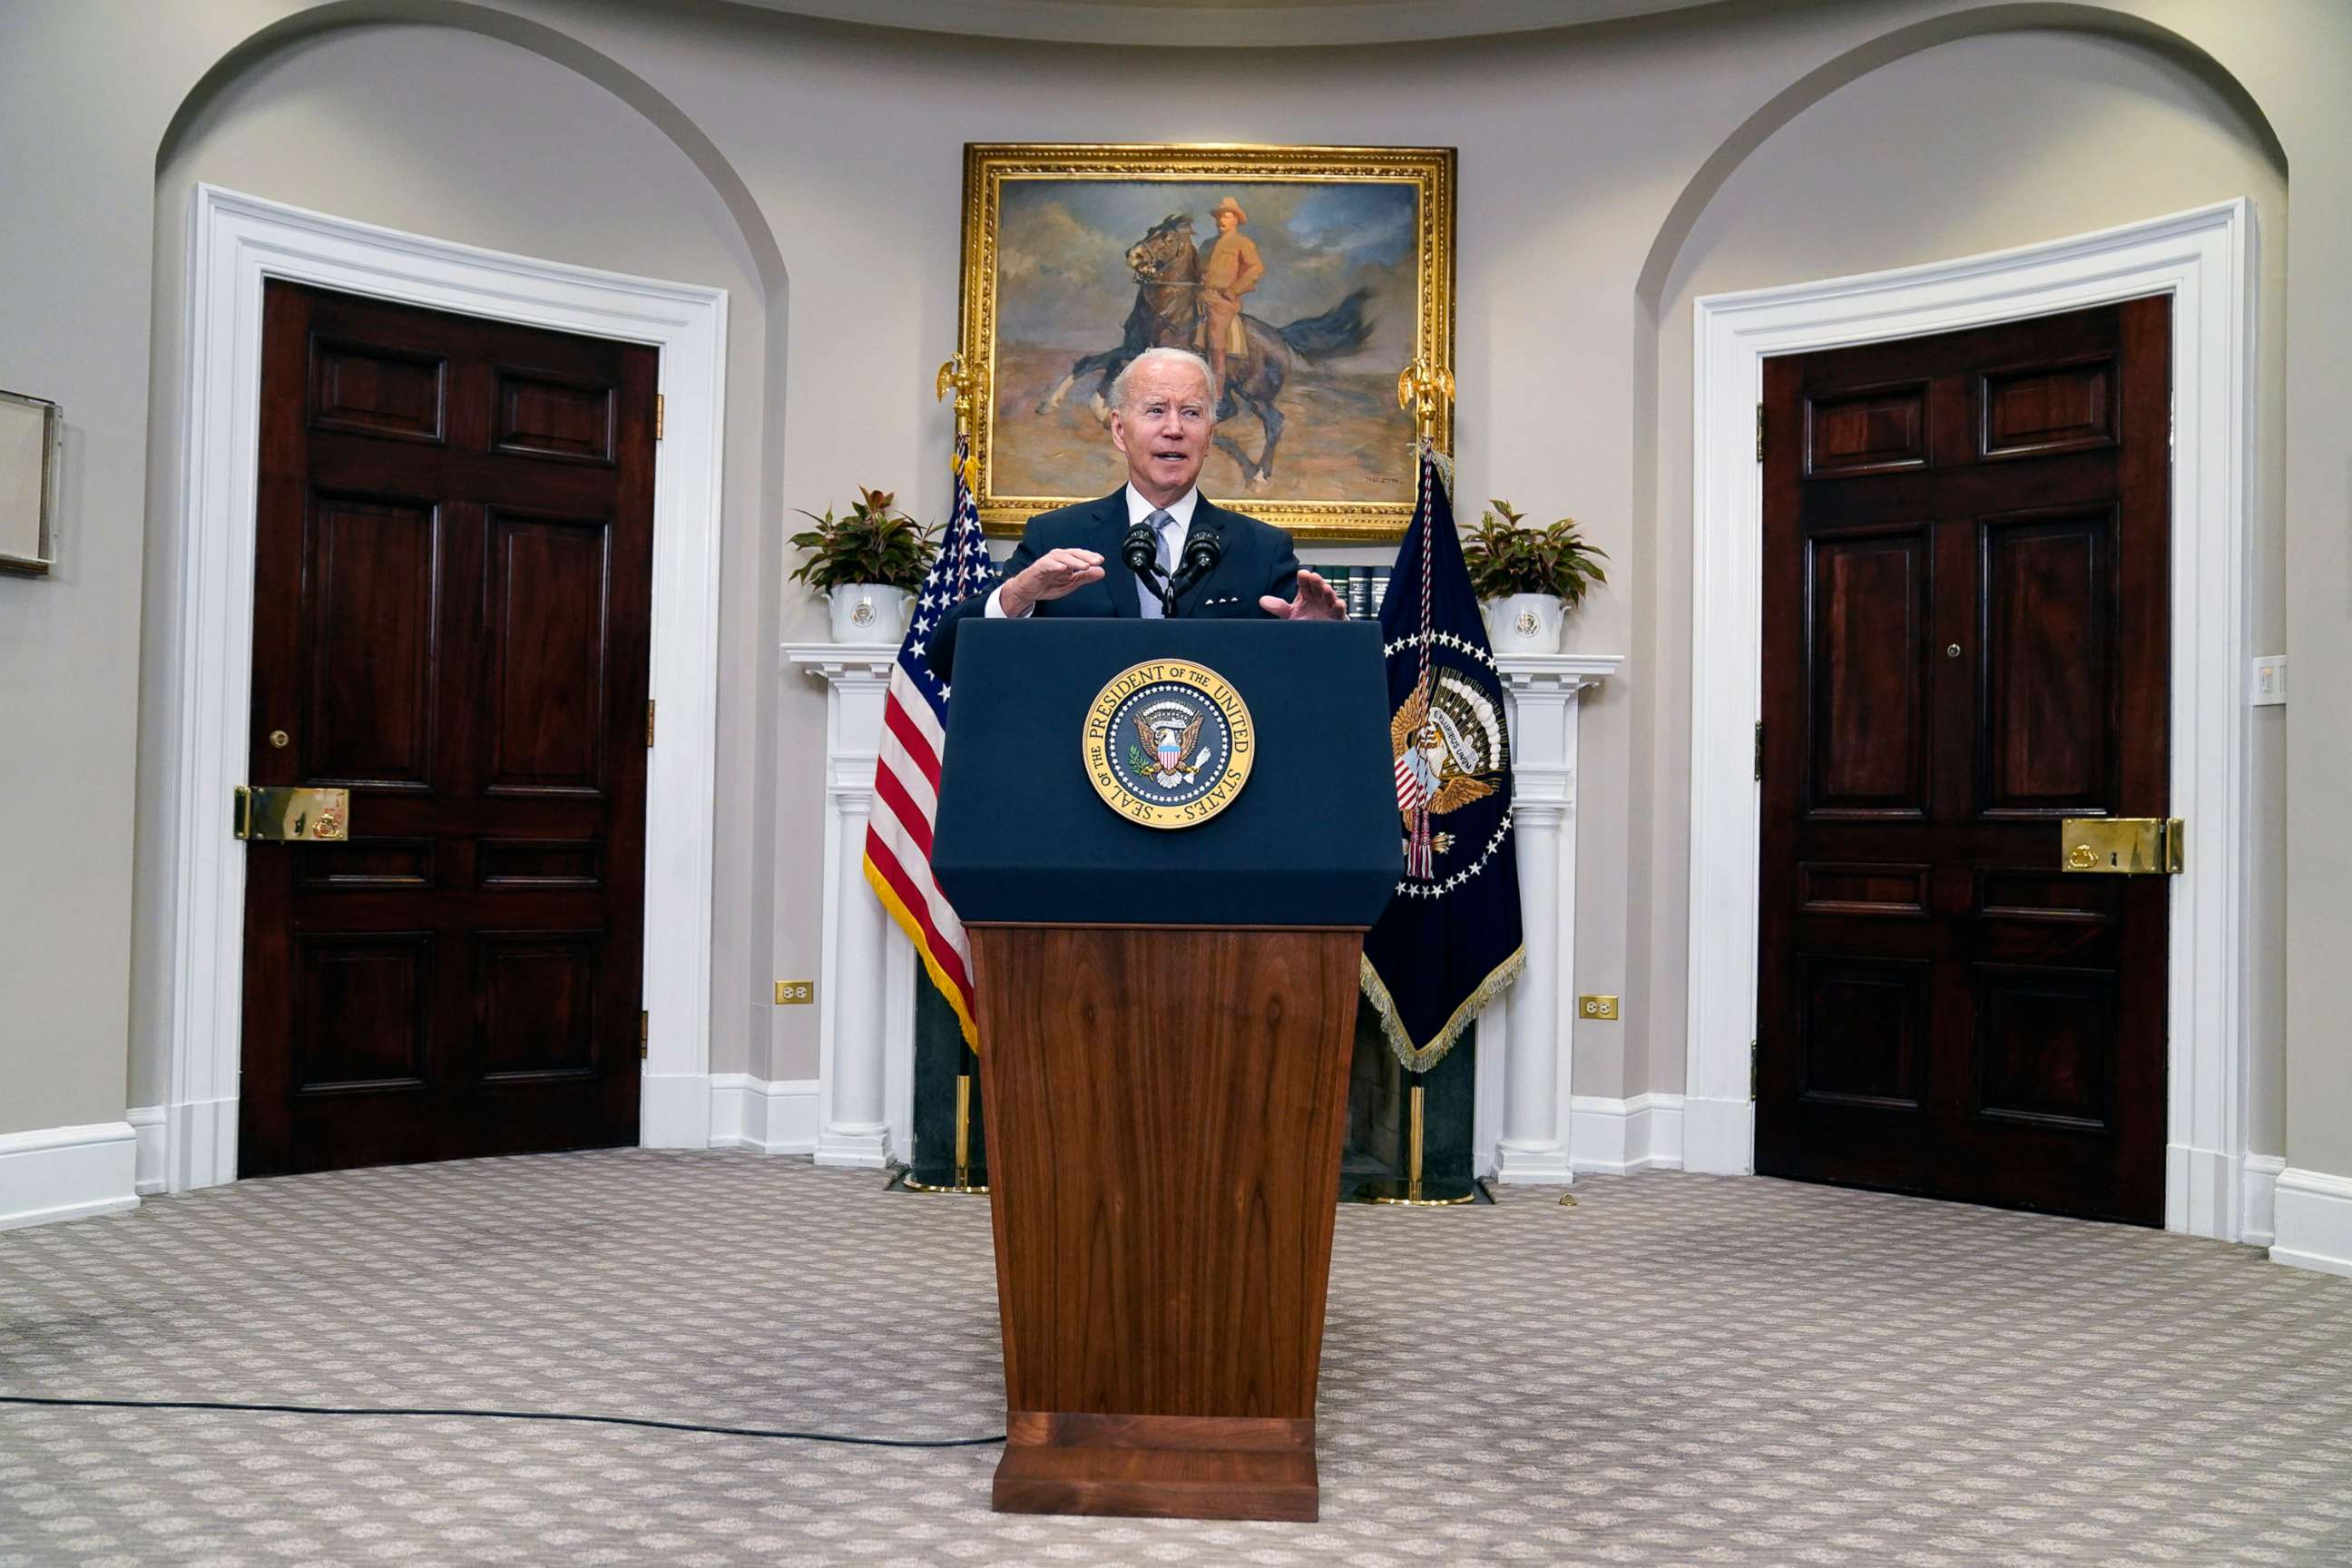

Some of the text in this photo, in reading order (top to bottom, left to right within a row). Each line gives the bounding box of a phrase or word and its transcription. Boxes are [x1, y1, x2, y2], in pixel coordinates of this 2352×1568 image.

[1090, 666, 1249, 819] SEAL OF THE PRESIDENT OF THE UNITED STATES
[1439, 715, 1459, 749] PLURIBUS
